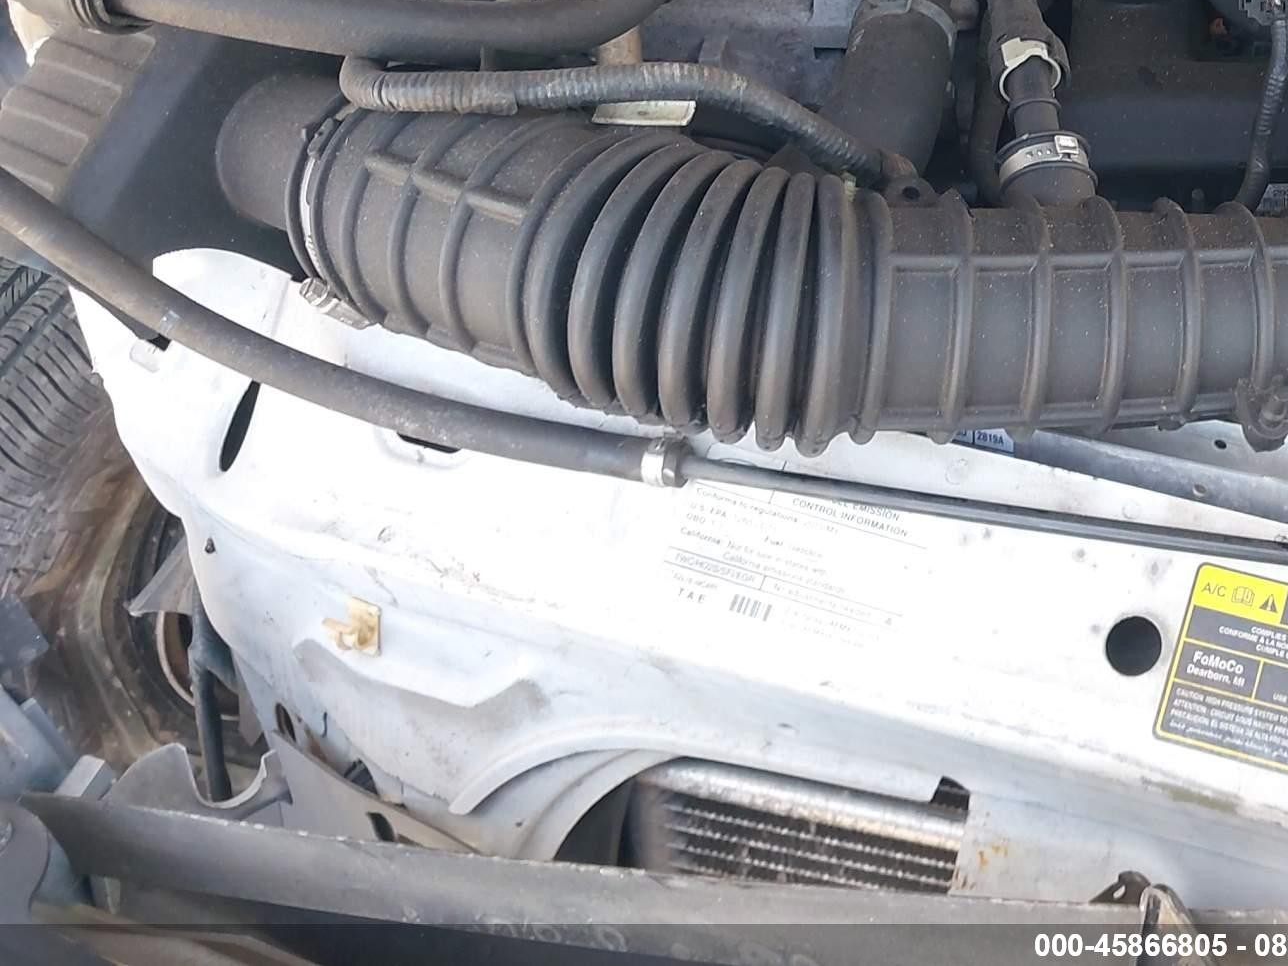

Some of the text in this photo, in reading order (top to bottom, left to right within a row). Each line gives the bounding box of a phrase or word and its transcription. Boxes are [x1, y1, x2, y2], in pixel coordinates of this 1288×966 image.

[792, 498, 838, 517] CONTROL
[840, 512, 908, 537] INFORMATION
[1201, 580, 1227, 598] A/C
[1191, 650, 1245, 676] FoMoCo
[1232, 675, 1246, 688] MI
